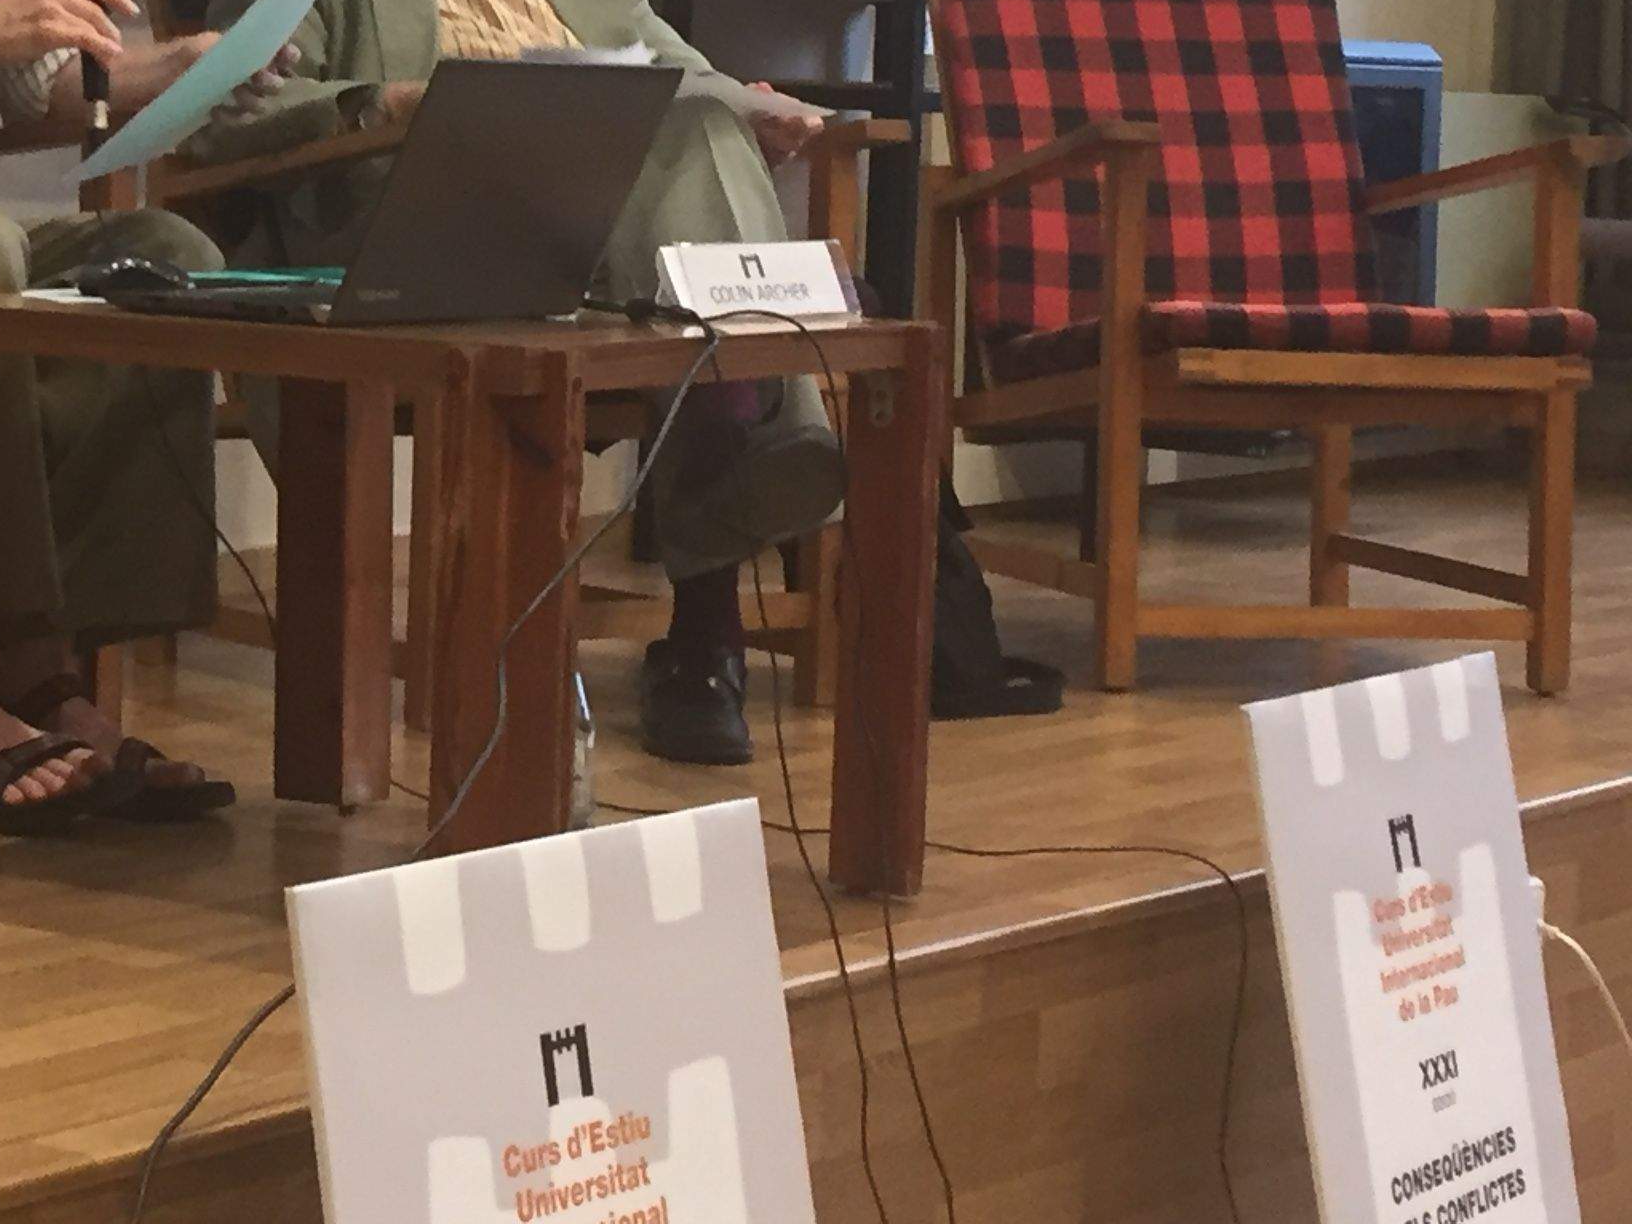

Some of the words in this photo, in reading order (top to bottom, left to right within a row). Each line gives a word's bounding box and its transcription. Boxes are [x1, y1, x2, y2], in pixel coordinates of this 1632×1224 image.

[709, 284, 755, 305] COLIN
[756, 282, 811, 301] ARCHER
[1419, 1049, 1459, 1090] XXXI
[503, 1142, 562, 1178] Curs
[567, 1111, 652, 1159] d'Estiu
[515, 1155, 652, 1223] Universitat
[1436, 1168, 1526, 1224] CONFLICTES
